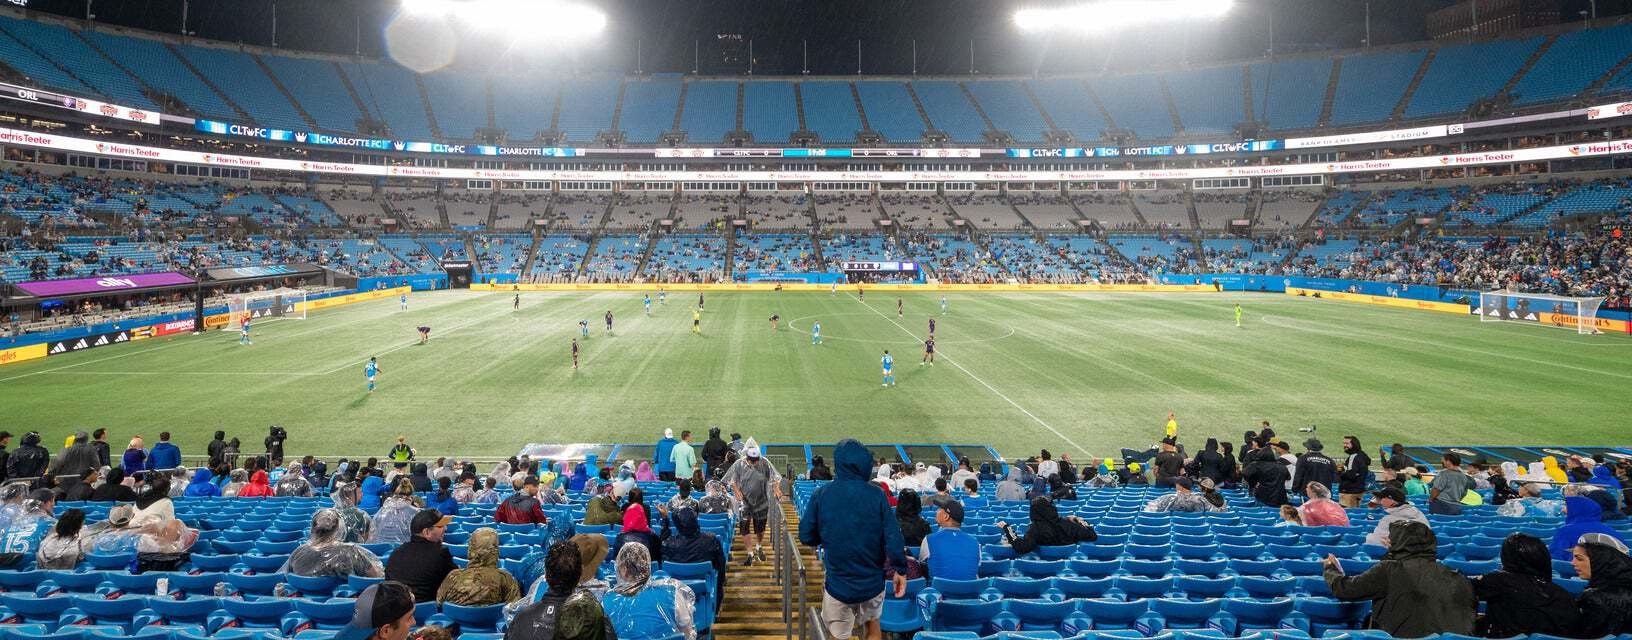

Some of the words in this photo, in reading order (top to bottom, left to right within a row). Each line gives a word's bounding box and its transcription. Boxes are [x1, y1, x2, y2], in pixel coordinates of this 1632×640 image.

[18, 89, 38, 100] ORL
[0, 132, 23, 142] arris
[24, 134, 52, 145] Teeter
[320, 136, 370, 147] CHARLOTTE
[372, 140, 382, 148] FC
[110, 145, 134, 155] Harris
[136, 148, 160, 157] Teeter
[498, 147, 541, 155] CHARLOTTE
[1589, 144, 1621, 152] Harris
[96, 277, 137, 288] ally
[5, 531, 32, 553] 15
